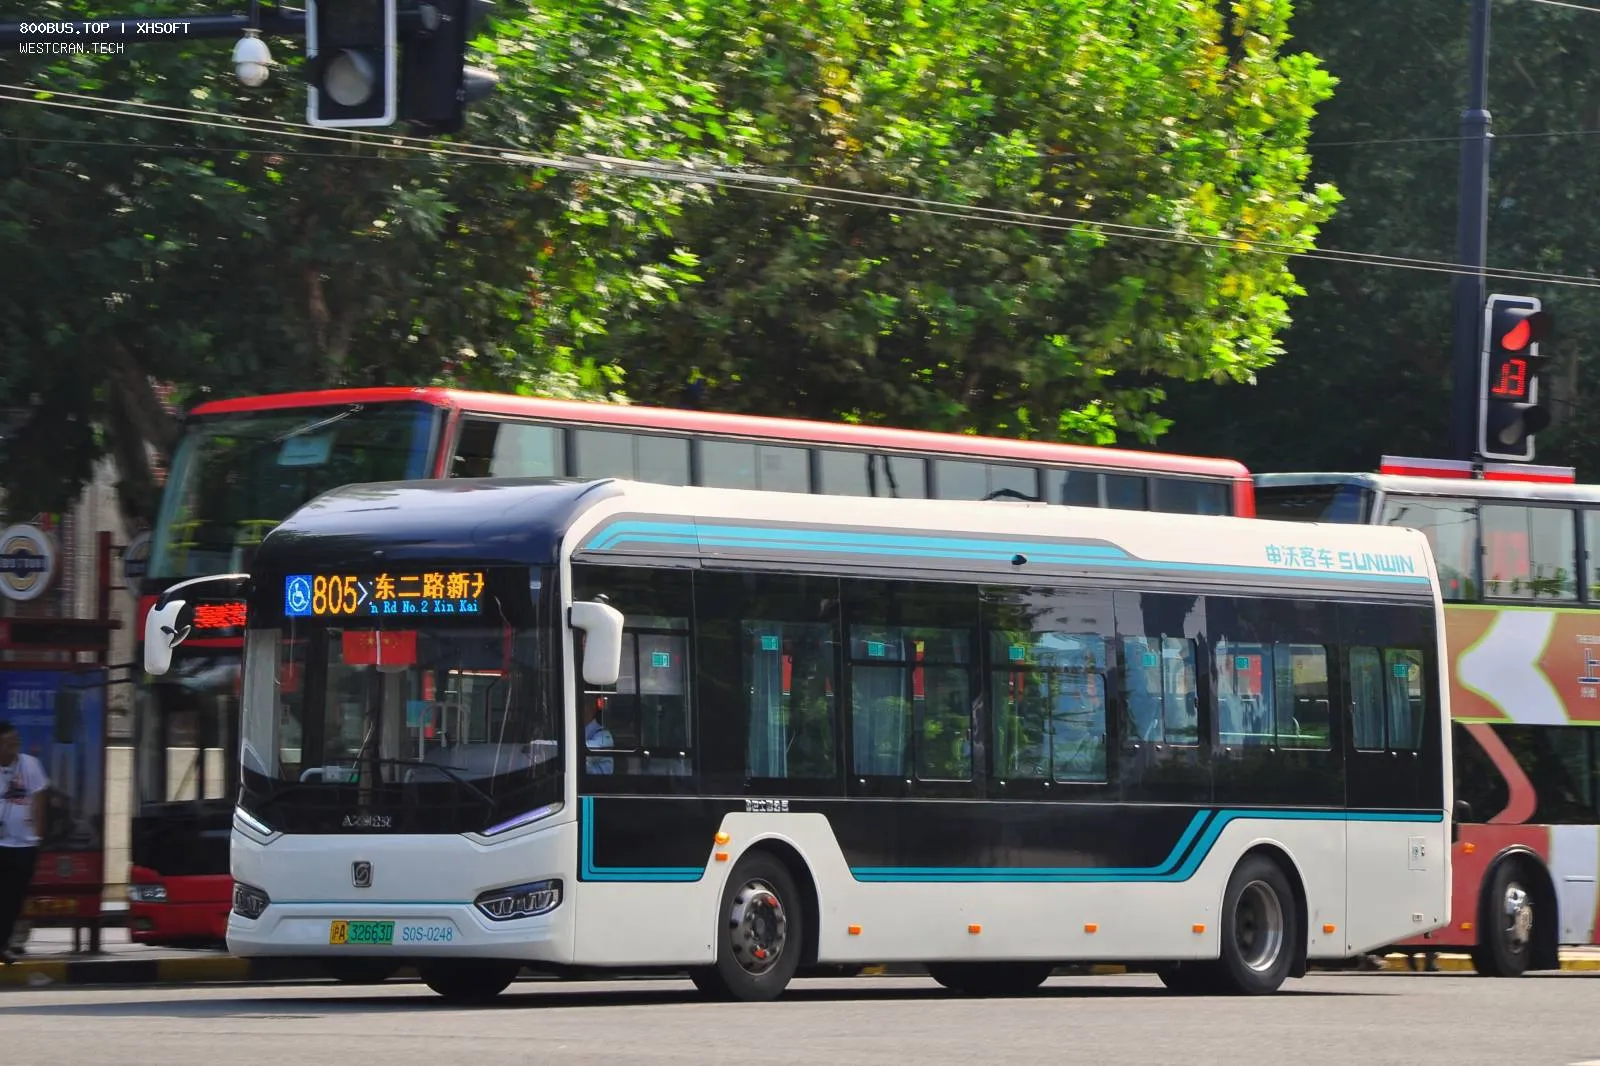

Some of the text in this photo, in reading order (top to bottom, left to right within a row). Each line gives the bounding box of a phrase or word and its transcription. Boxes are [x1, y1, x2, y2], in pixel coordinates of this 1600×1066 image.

[1264, 544, 1415, 573] 申沃客车 SUNWIN
[313, 575, 358, 615] 805
[383, 600, 397, 613] Rd
[433, 600, 454, 613] Xin
[460, 600, 478, 612] Kai
